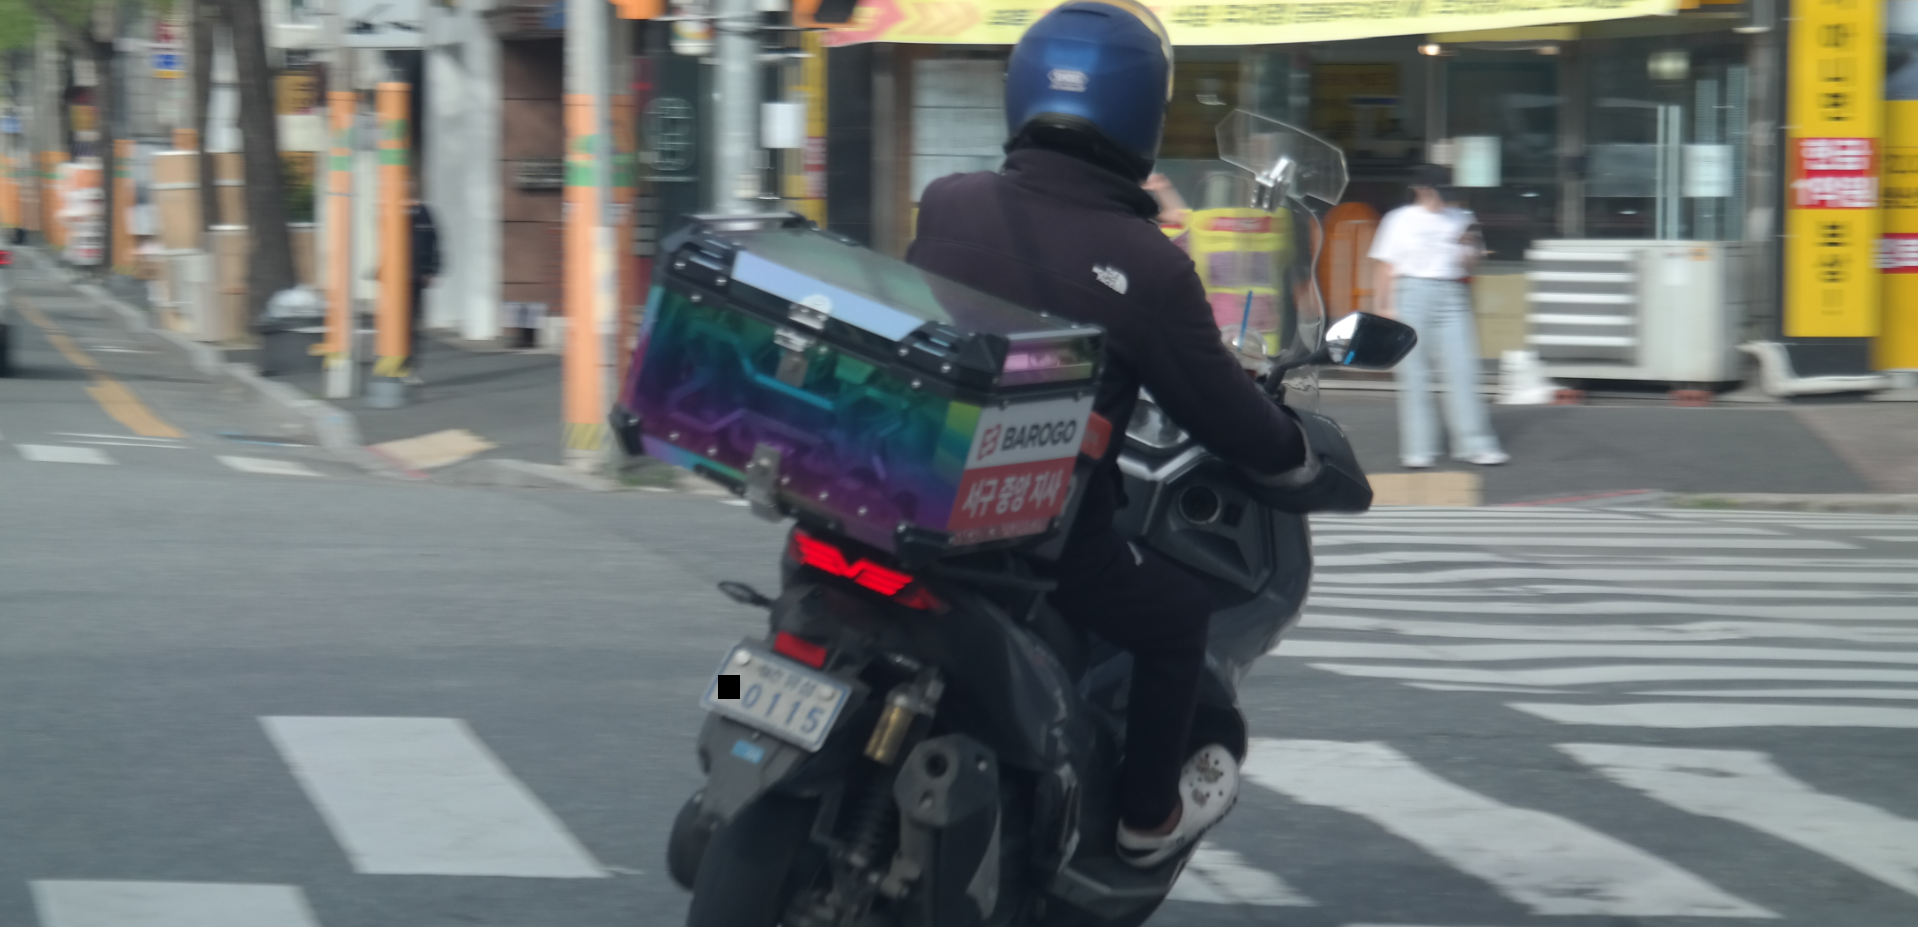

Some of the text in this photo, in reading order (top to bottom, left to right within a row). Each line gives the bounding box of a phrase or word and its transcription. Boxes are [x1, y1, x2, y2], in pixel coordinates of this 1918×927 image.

[1001, 419, 1077, 451] BAROGO
[962, 468, 1065, 518] 서구 중앙 지사
[741, 683, 824, 733] 0115
